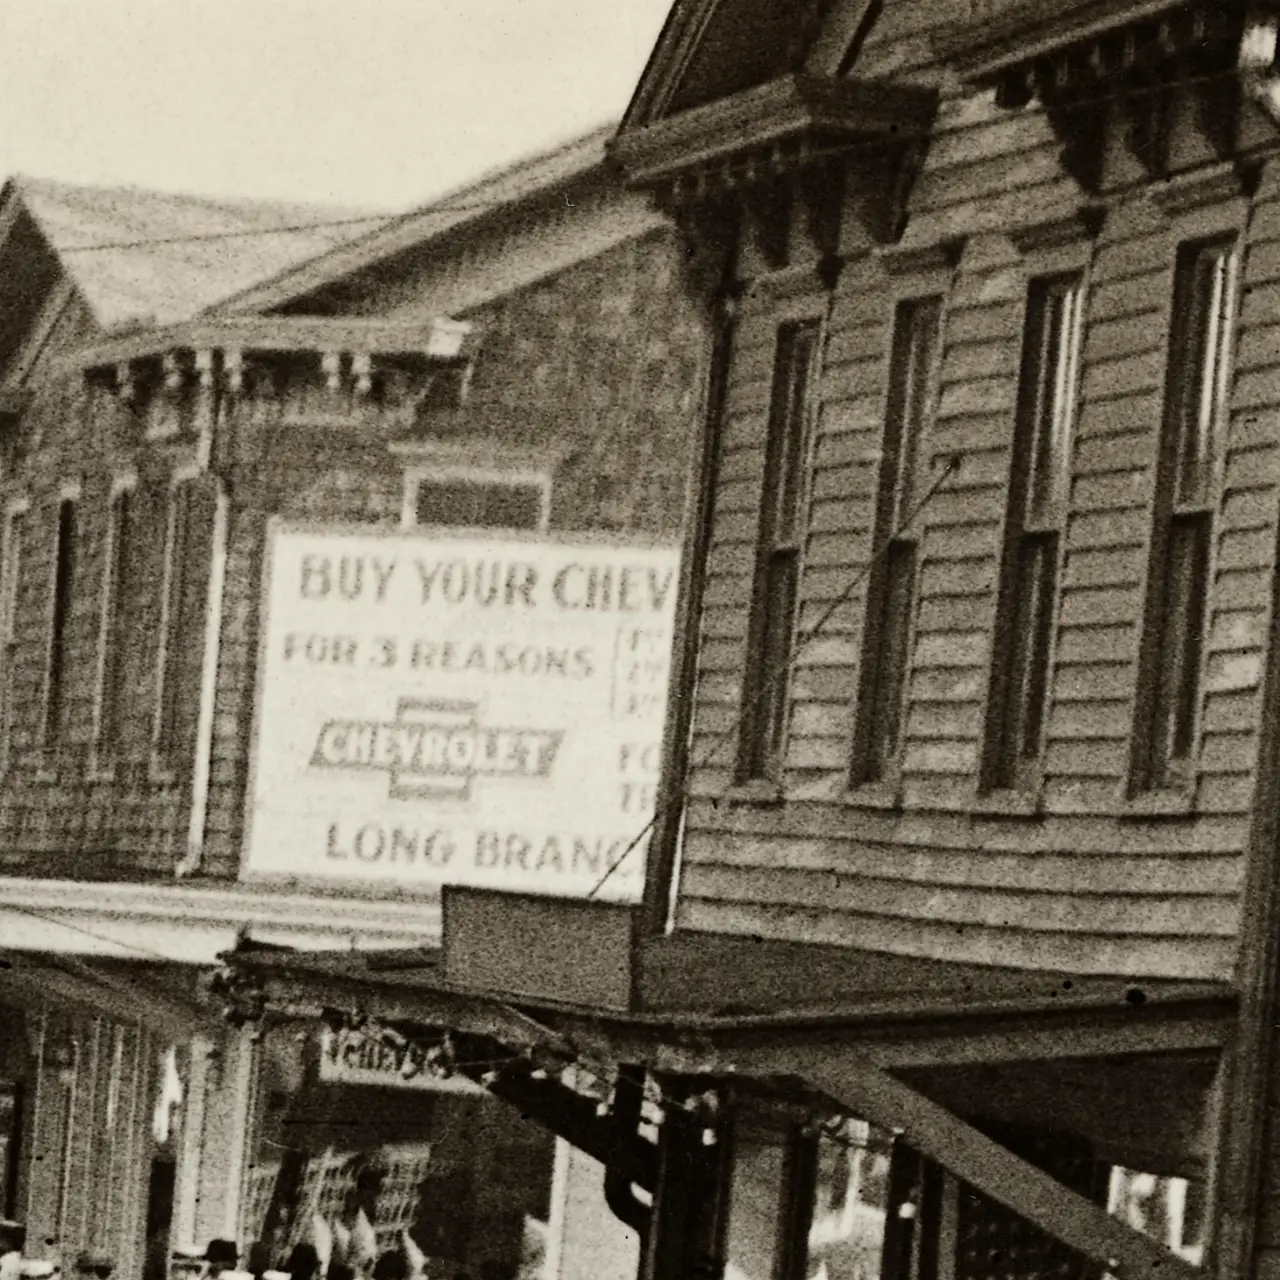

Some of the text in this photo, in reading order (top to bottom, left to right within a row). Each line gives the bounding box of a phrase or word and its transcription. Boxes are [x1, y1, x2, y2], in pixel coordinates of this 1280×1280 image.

[299, 554, 396, 600] BUY
[414, 557, 539, 606] YOUR
[283, 631, 359, 667] FOR
[369, 635, 398, 668] 3
[410, 638, 597, 678] REASONS
[320, 724, 544, 774] CHEVROLET
[325, 822, 457, 867] LONG
